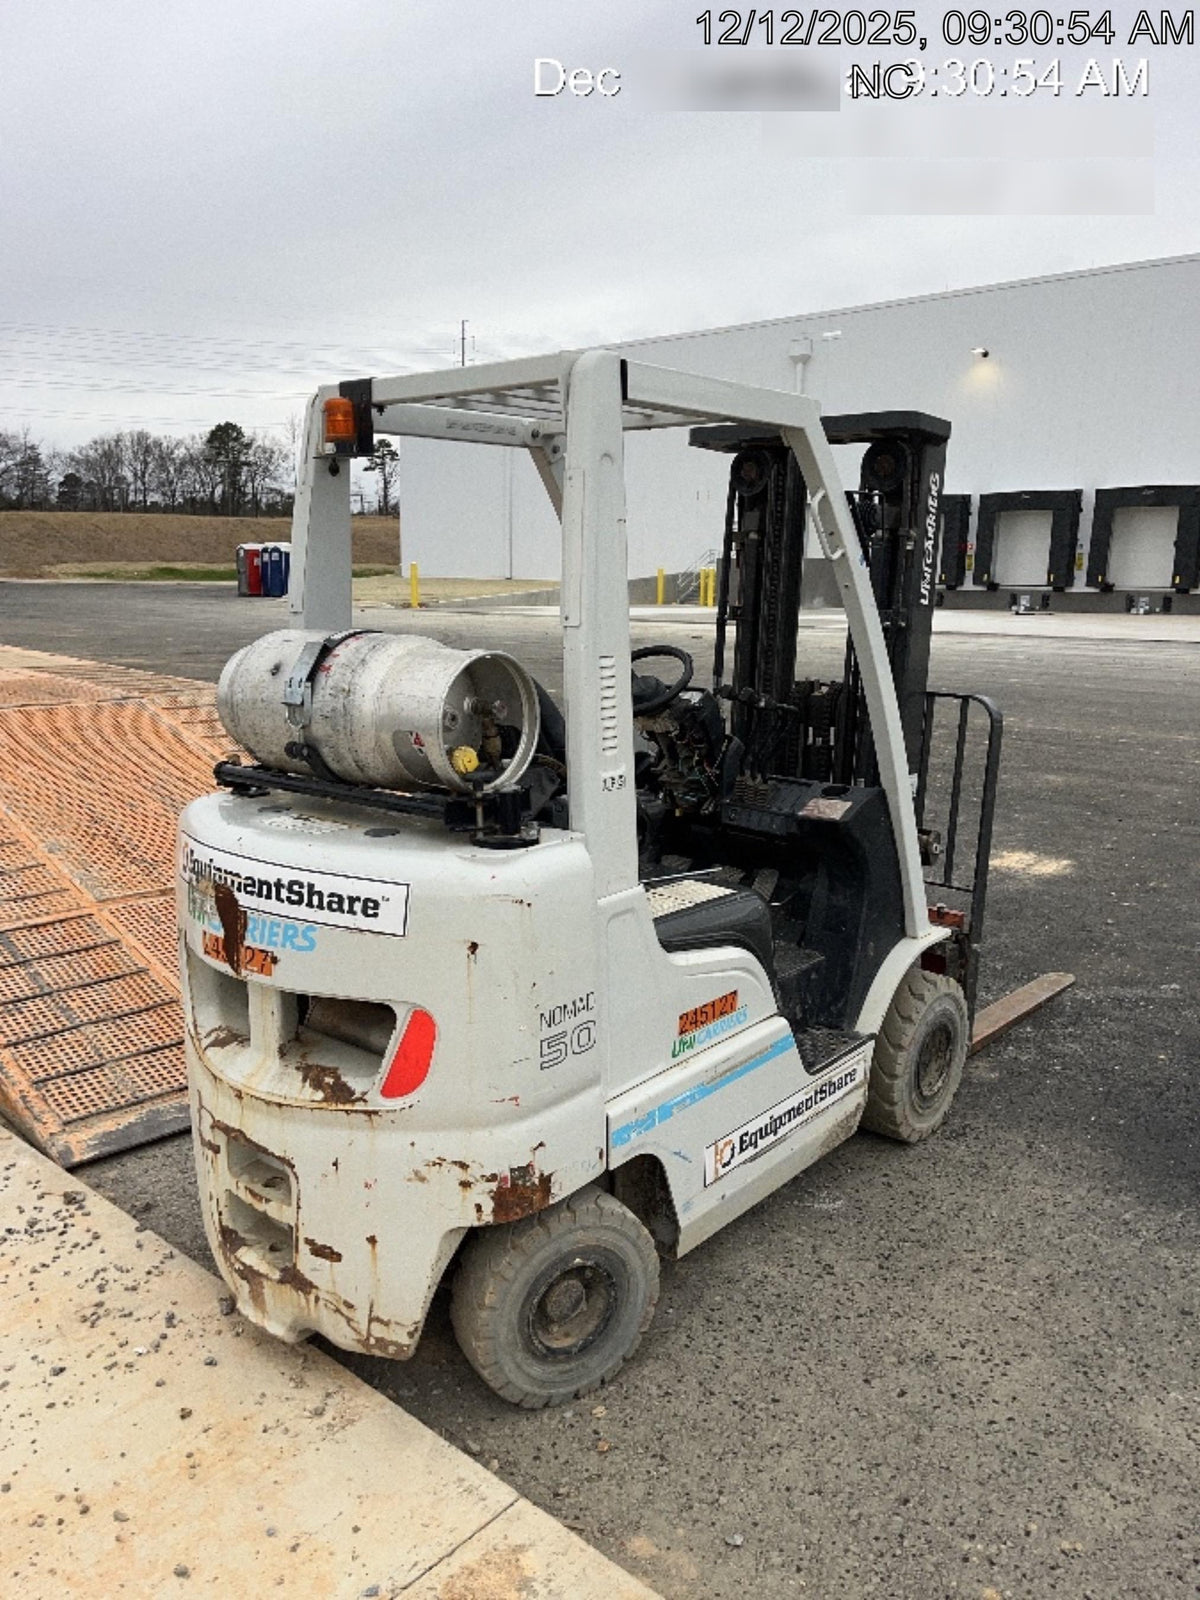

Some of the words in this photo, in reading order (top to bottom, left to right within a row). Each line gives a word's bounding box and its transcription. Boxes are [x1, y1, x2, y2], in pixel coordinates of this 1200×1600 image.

[539, 991, 596, 1031] NOMAD
[539, 1020, 597, 1071] 50
[738, 1067, 858, 1156] EquipmentShare
